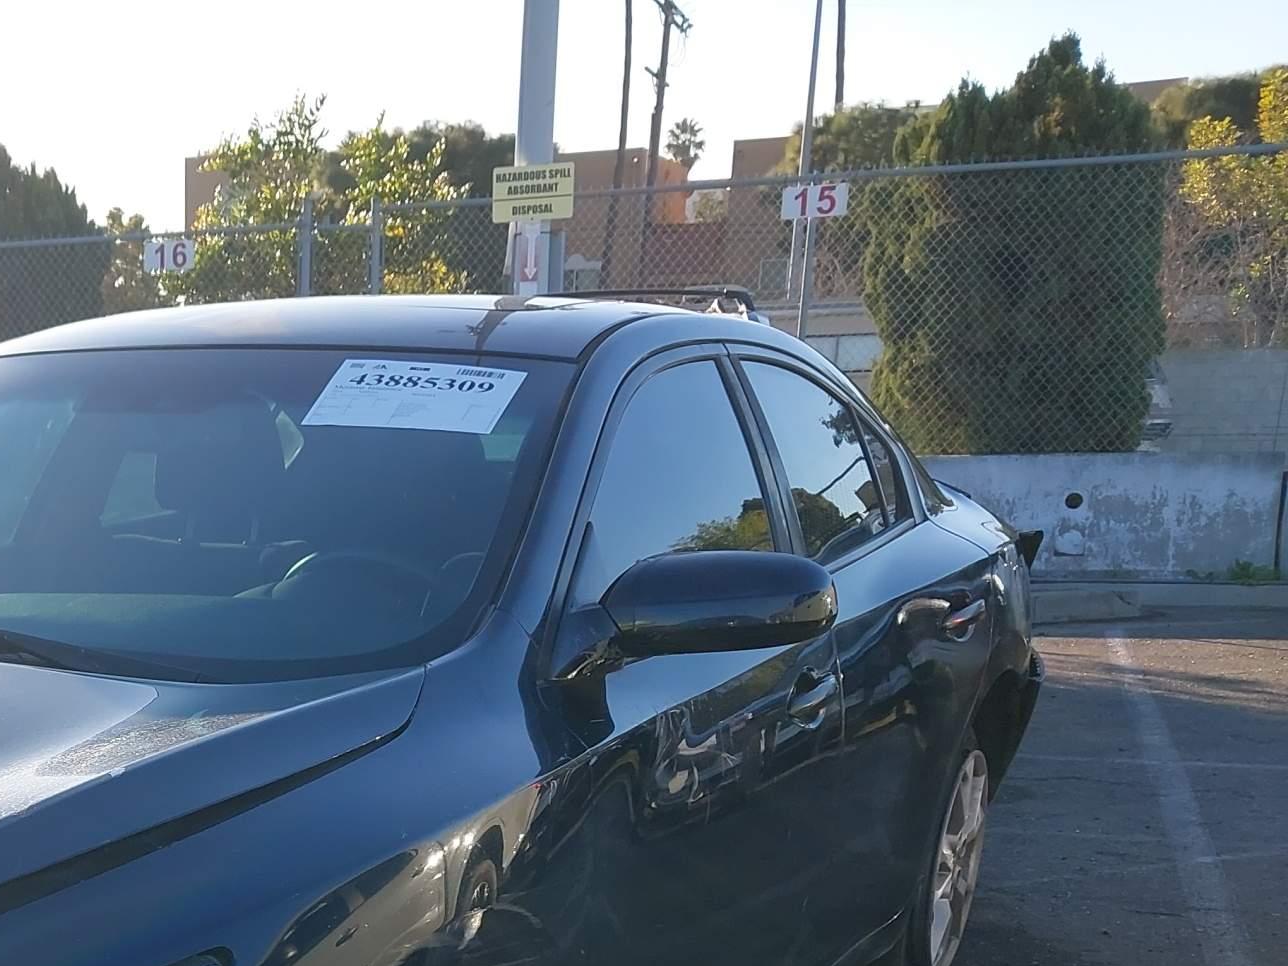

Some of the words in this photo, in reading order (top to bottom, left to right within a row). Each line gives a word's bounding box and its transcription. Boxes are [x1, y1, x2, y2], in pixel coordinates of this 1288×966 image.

[496, 170, 547, 183] HAZARDOUS
[548, 168, 571, 180] SPILL
[512, 203, 553, 216] DISPOSAL
[794, 185, 837, 216] 15
[155, 242, 187, 270] 16
[348, 373, 495, 393] 43885309
